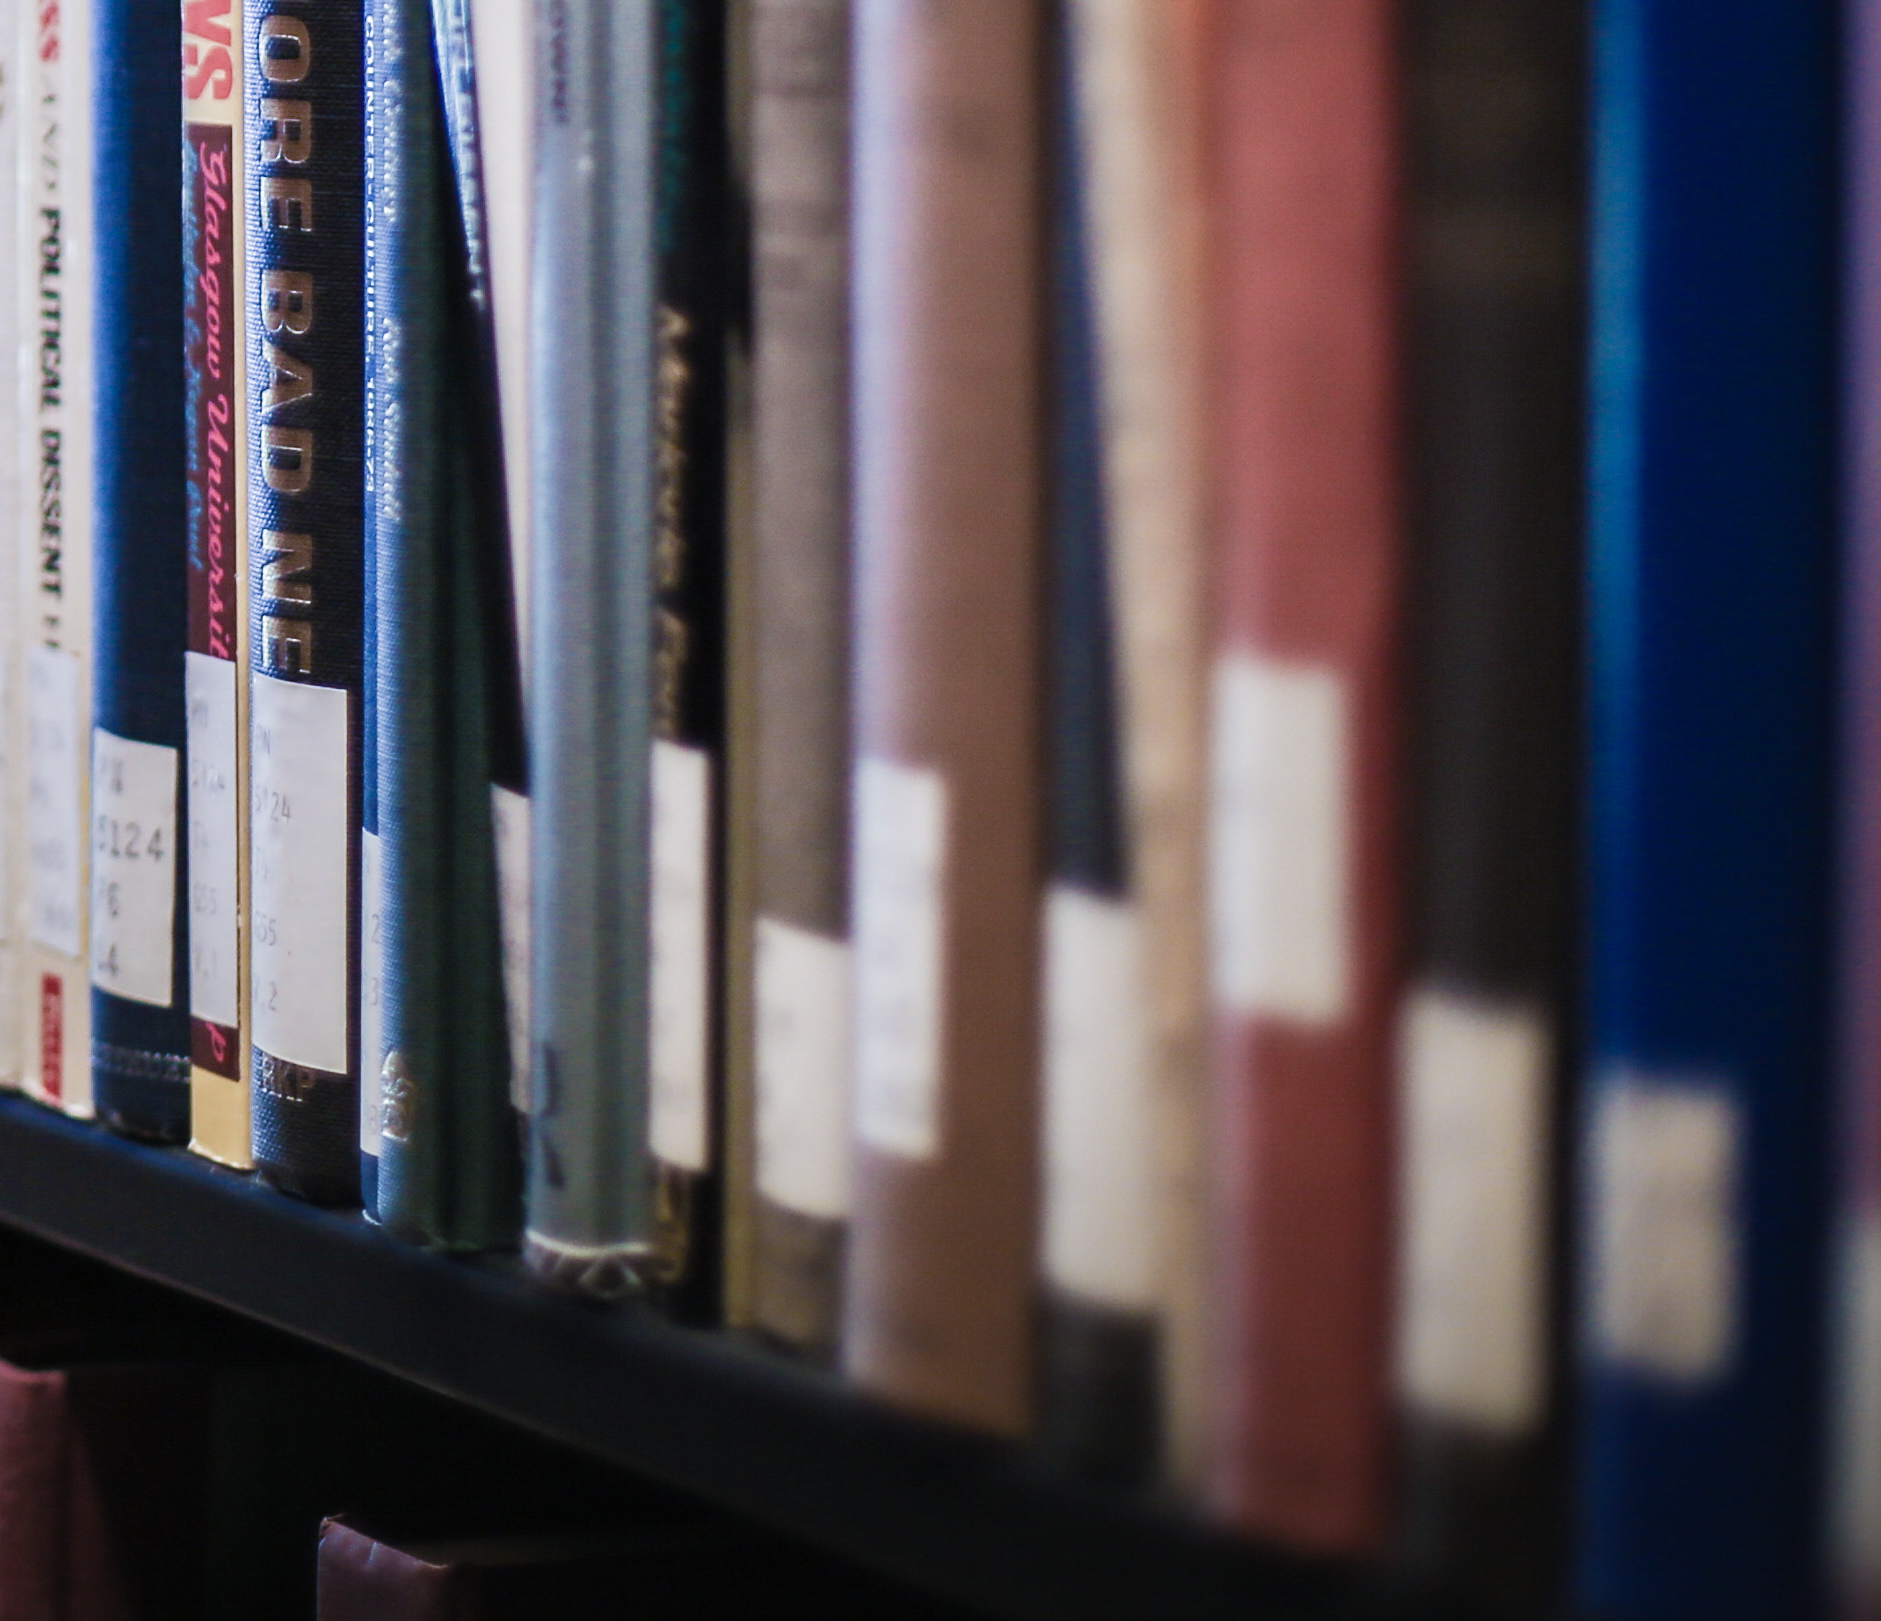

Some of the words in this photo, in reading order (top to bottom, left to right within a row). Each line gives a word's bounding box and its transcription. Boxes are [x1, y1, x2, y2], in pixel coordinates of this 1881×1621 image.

[39, 206, 63, 414] POLITICAL
[199, 142, 228, 379] Glasgow
[259, 268, 316, 494] BAD
[40, 428, 63, 600] DISSENT
[207, 393, 231, 659] Universit
